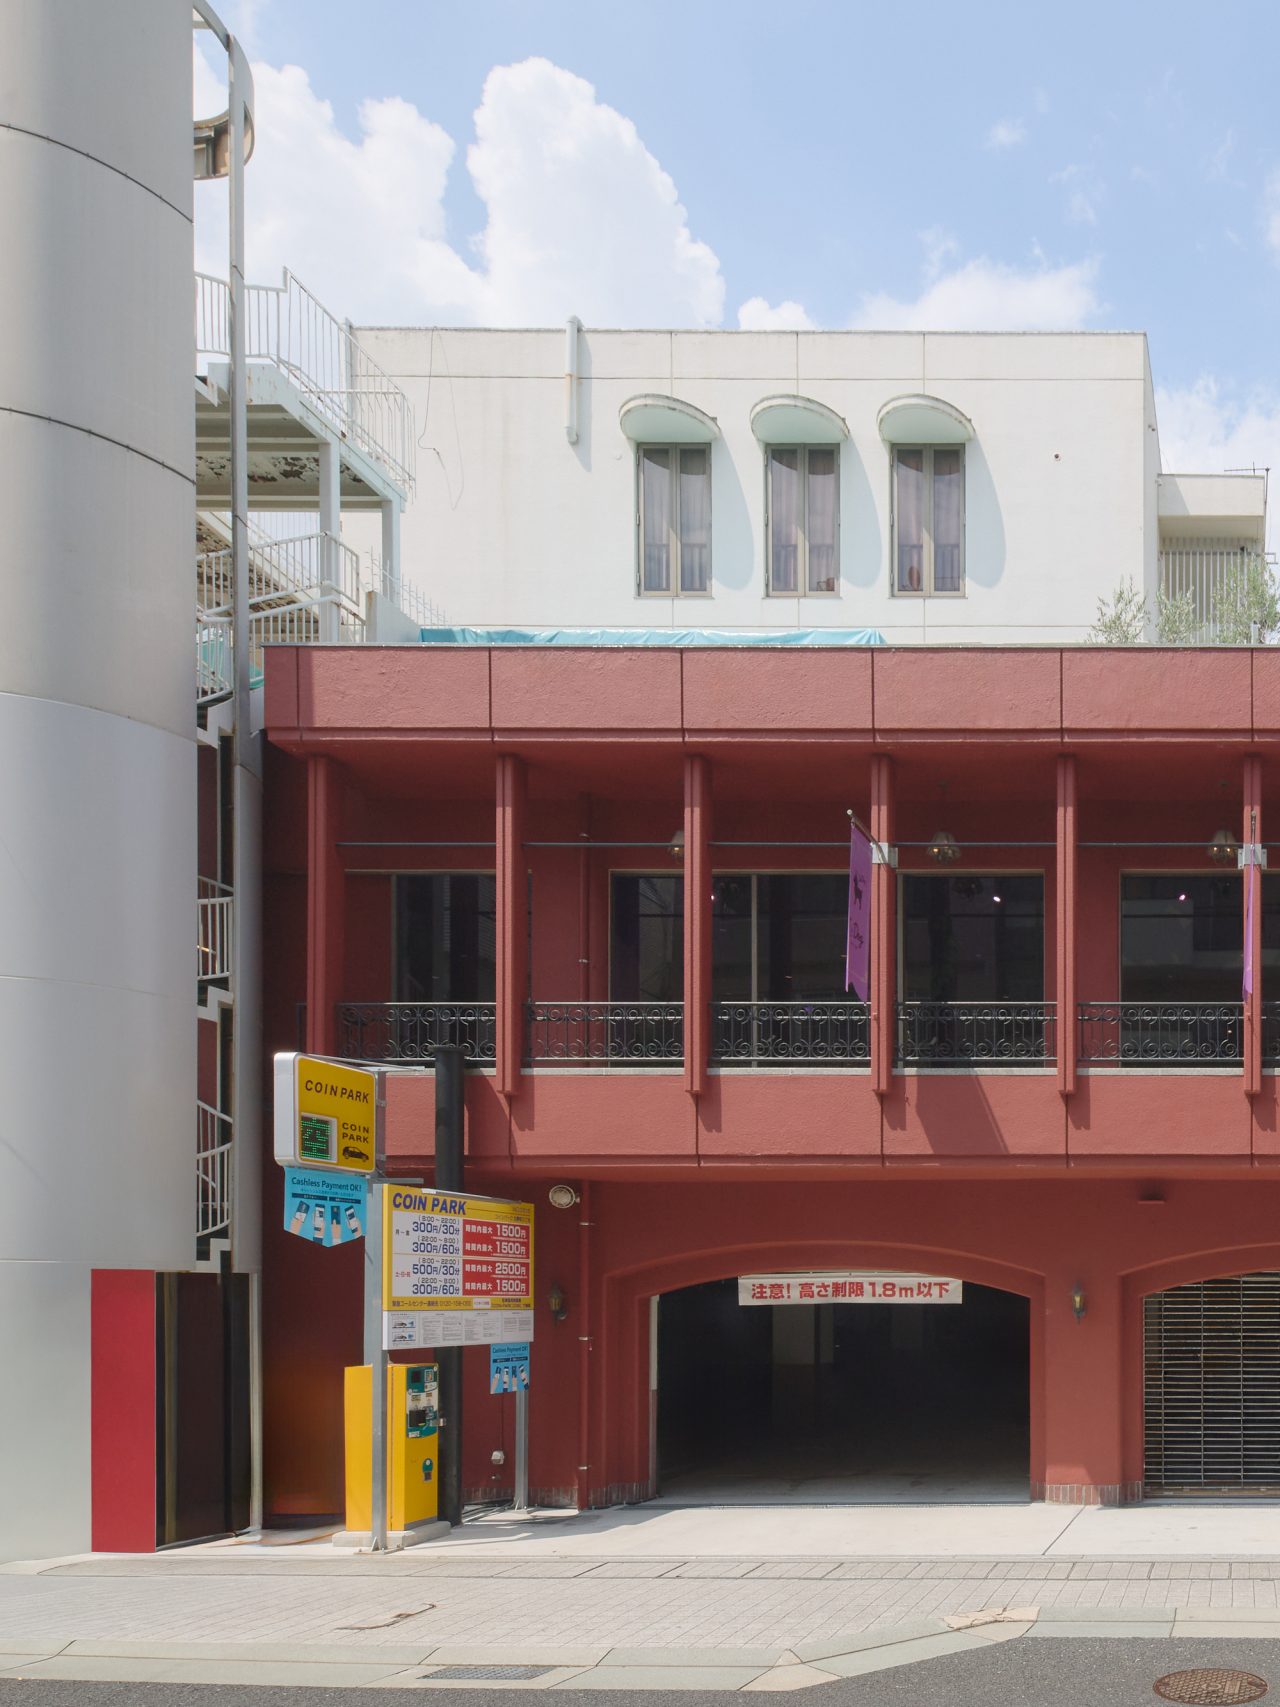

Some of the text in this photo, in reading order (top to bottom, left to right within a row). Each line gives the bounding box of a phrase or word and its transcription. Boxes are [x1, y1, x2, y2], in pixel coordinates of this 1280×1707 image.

[305, 1079, 369, 1104] COIN PARK
[342, 1122, 370, 1134] COIN
[342, 1132, 369, 1144] PARK
[291, 1176, 321, 1188] Cashless
[321, 1179, 349, 1191] Payment
[349, 1182, 362, 1193] OK!
[392, 1192, 467, 1216] COIN PARK
[496, 1224, 526, 1238] 1500円
[495, 1241, 526, 1255] 1500円
[495, 1262, 526, 1275] 2500円
[495, 1279, 526, 1292] 1500円
